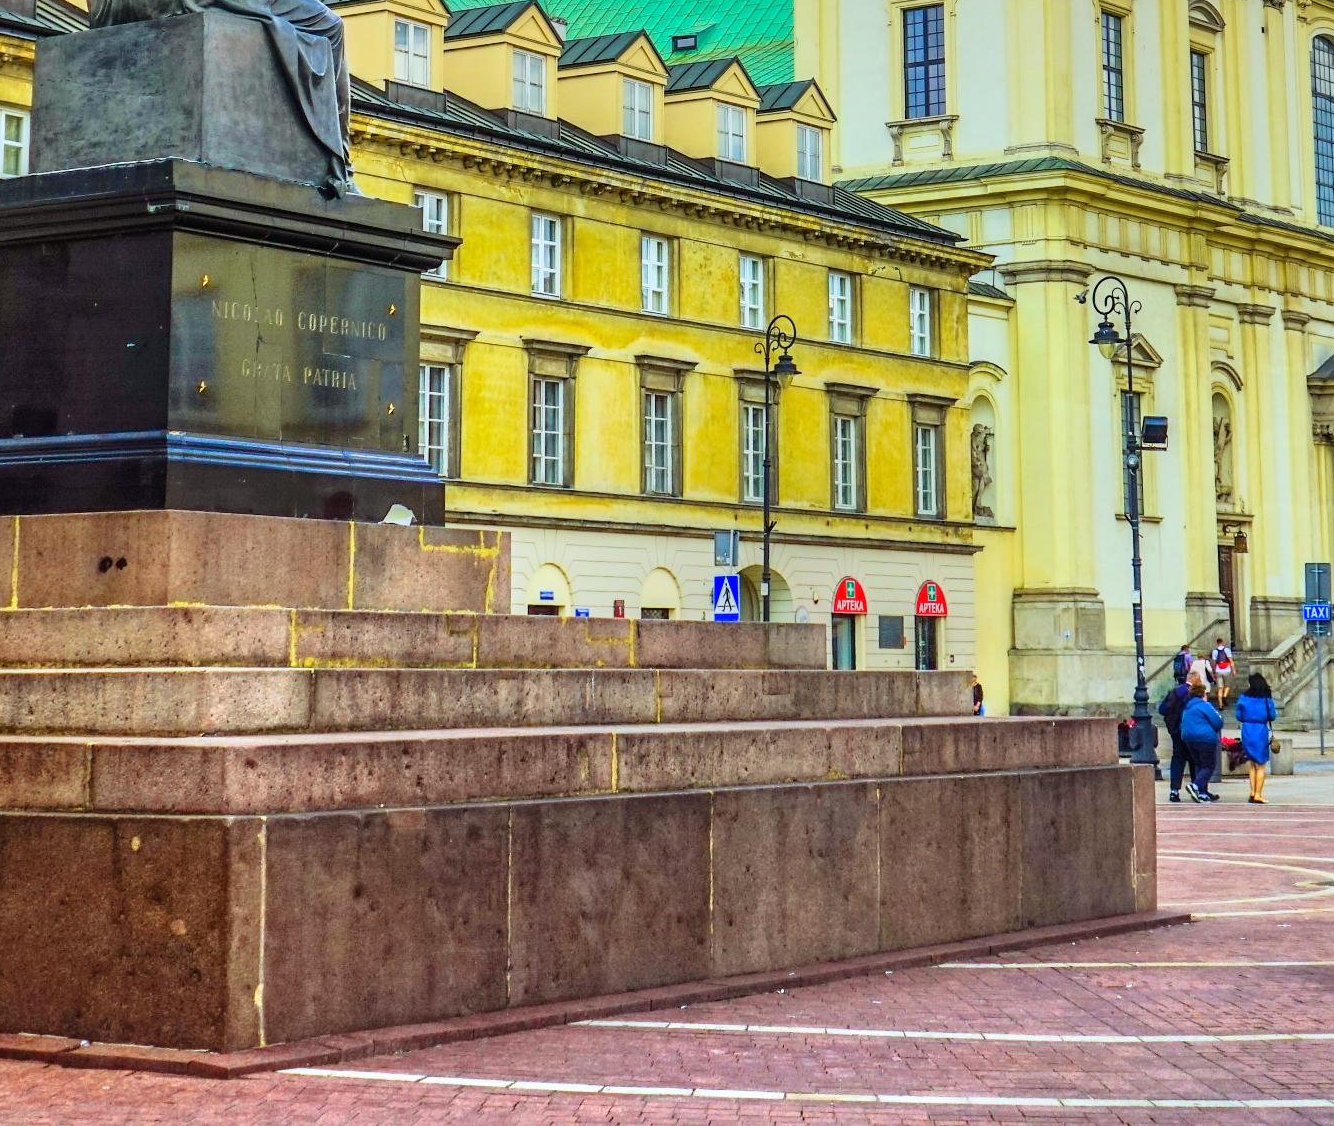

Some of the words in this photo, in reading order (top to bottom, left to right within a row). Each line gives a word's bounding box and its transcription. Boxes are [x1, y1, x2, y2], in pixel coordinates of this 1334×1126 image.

[297, 311, 387, 342] COPERNICO
[303, 366, 357, 390] PATRIA
[837, 600, 864, 611] APTEKA
[919, 603, 944, 614] APTEKA
[1305, 607, 1329, 619] TAXI
